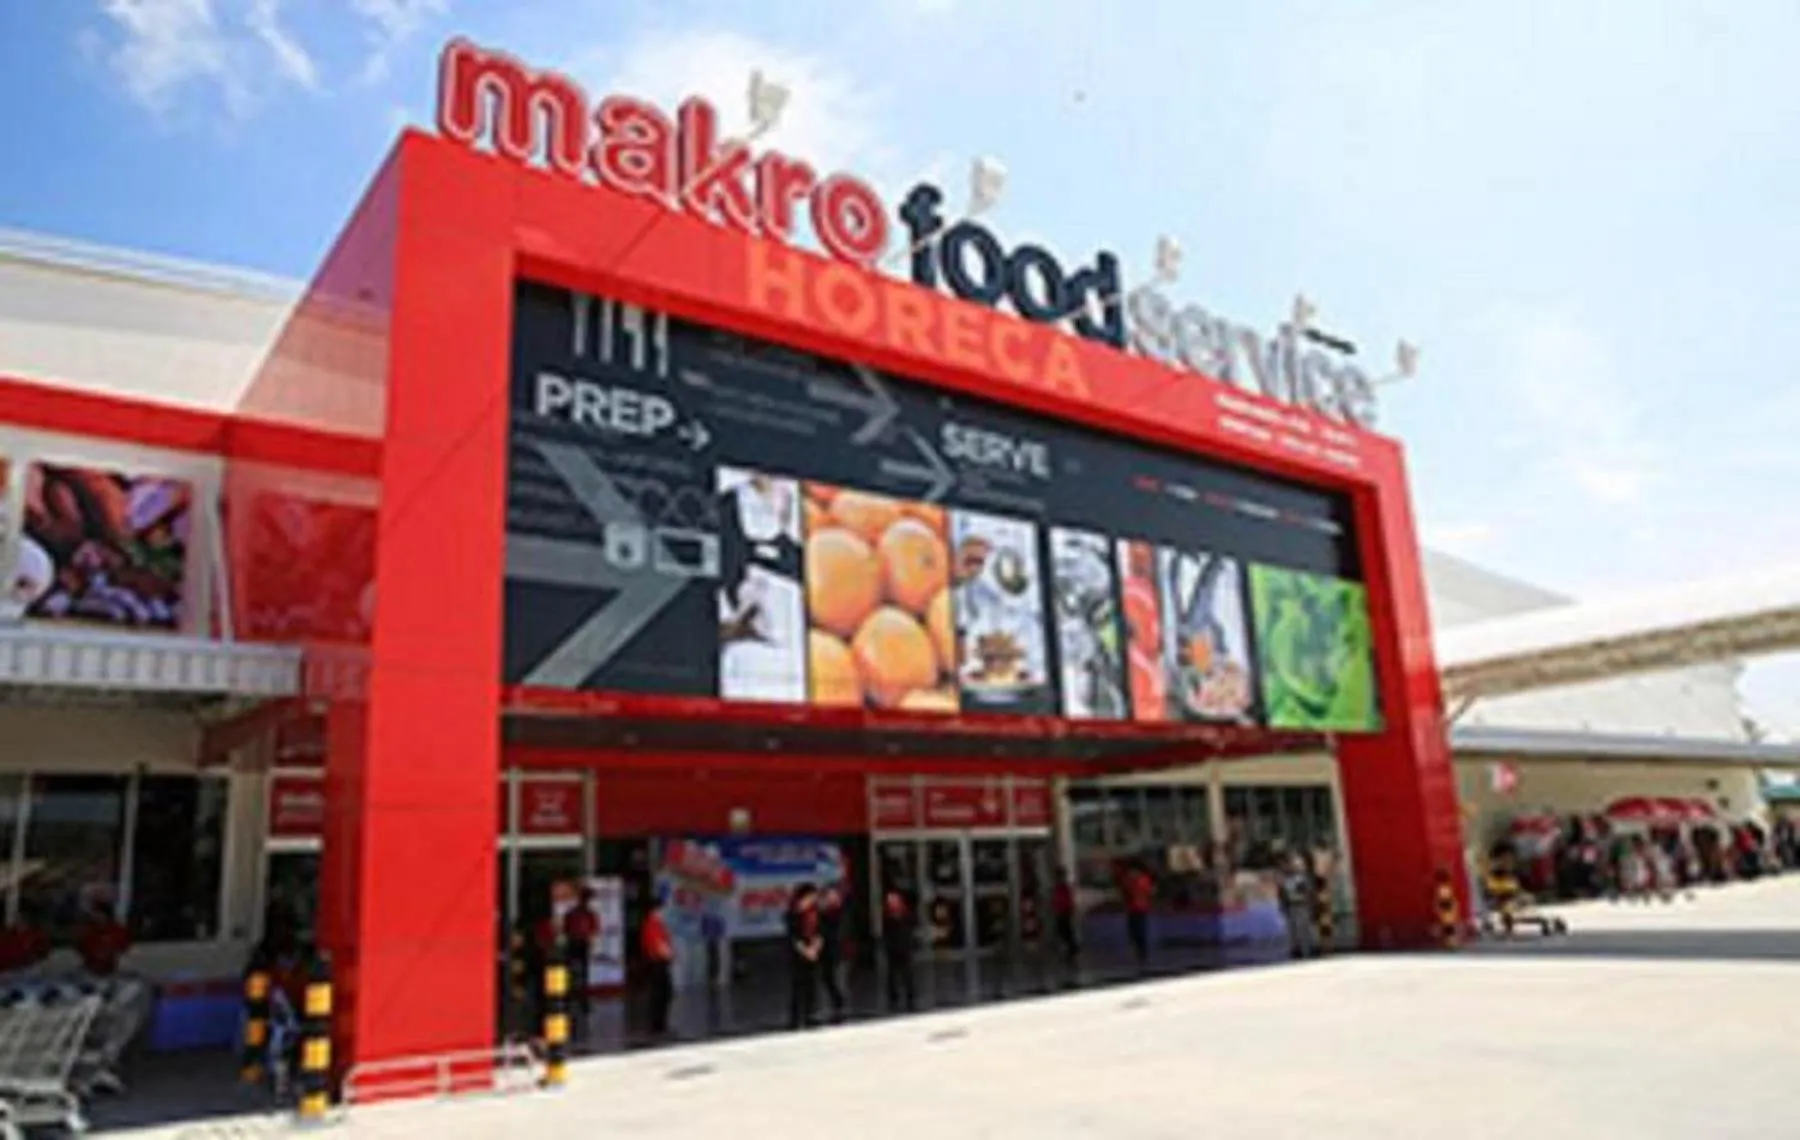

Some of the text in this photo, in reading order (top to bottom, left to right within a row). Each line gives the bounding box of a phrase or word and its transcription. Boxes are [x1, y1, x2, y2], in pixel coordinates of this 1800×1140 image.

[439, 37, 1377, 425] makro food service
[747, 240, 1091, 398] HORECA
[536, 372, 677, 434] PREP
[941, 421, 1051, 479] SERVE
